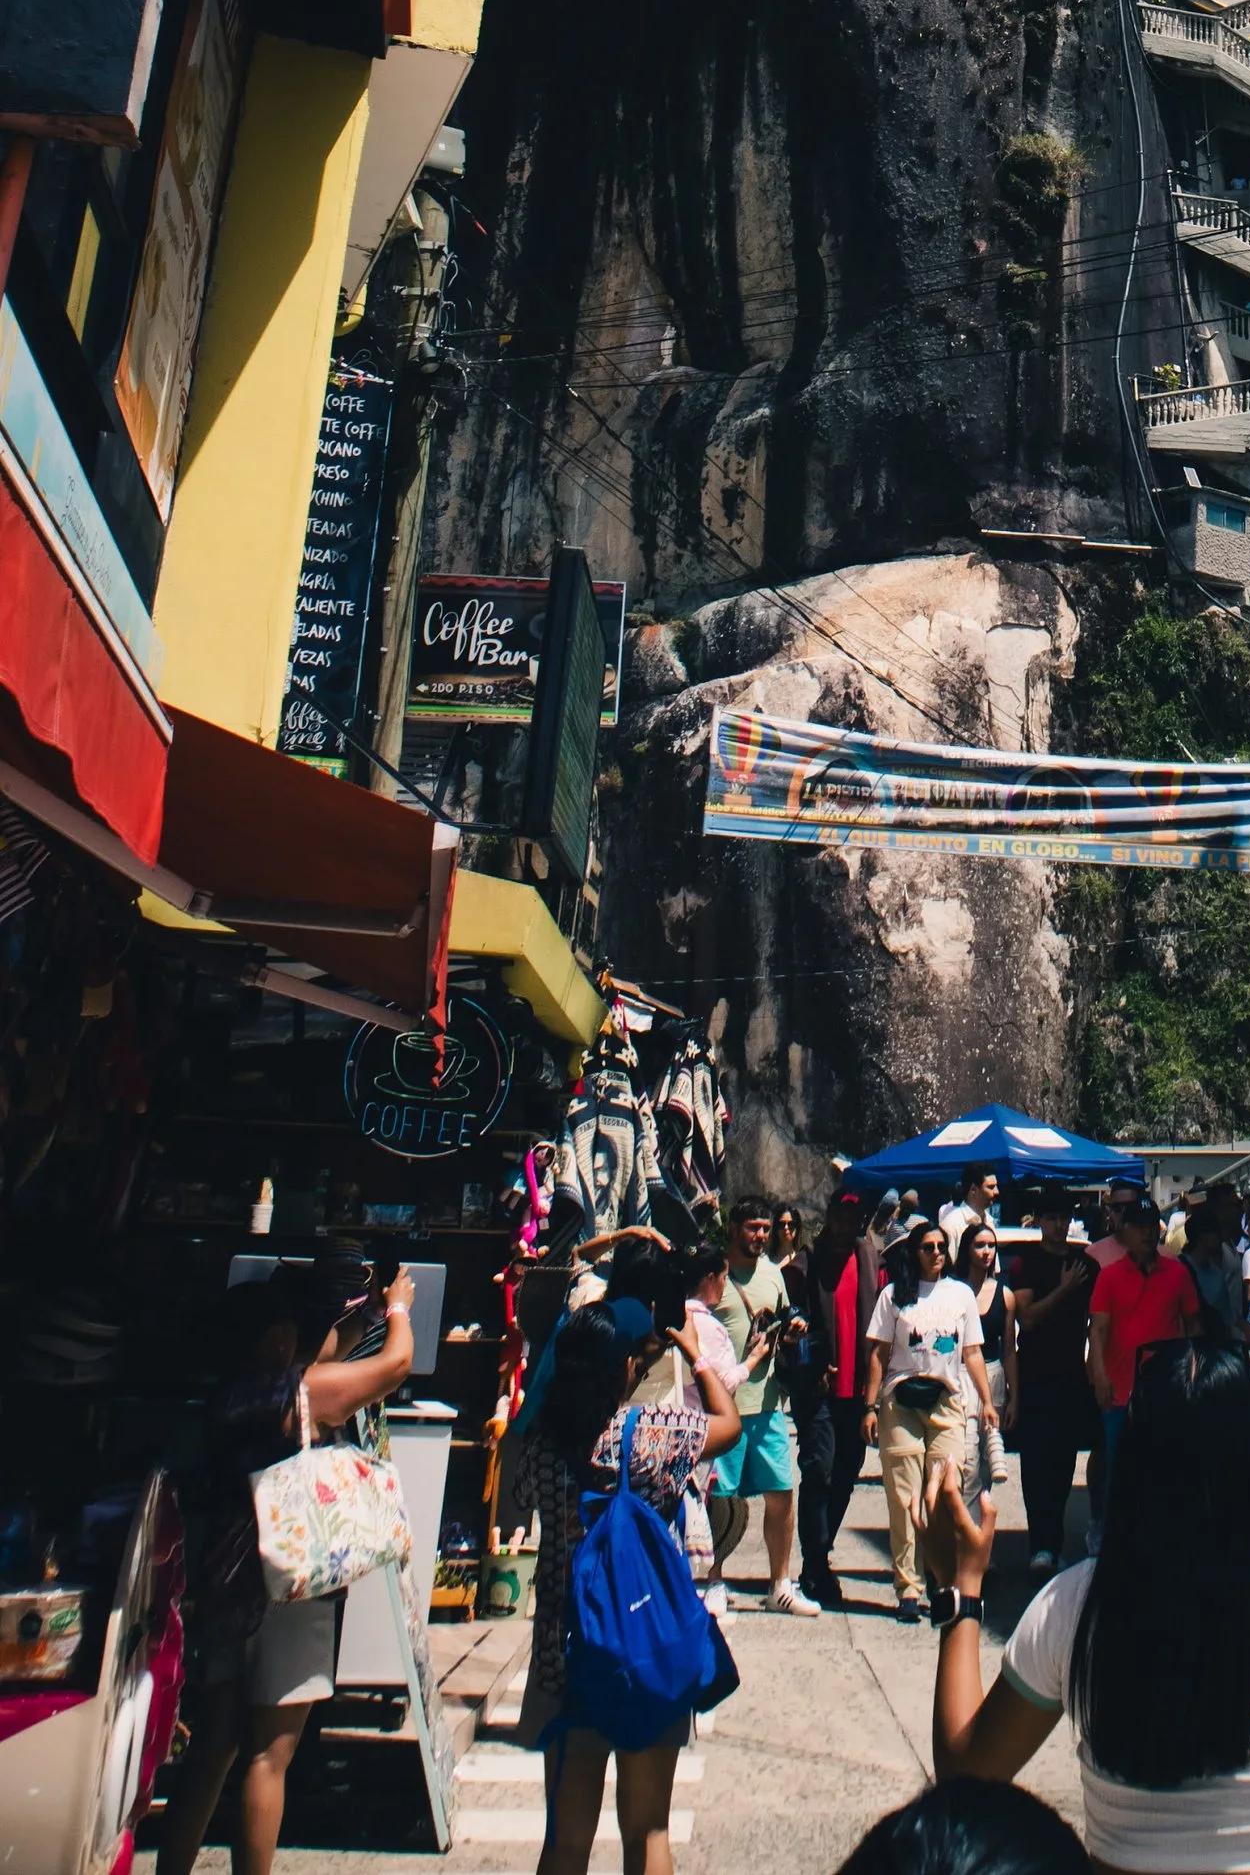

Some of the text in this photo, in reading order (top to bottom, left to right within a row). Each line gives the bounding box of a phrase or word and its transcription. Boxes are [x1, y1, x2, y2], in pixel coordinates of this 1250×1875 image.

[325, 393, 367, 414] COFFE
[345, 420, 385, 441] COFFE
[423, 598, 515, 662] Coffee
[476, 637, 531, 667] Bar
[431, 682, 494, 695] 2DO PISO
[818, 827, 841, 841] EL
[850, 828, 889, 845] QUE
[896, 831, 968, 852] MONTO
[979, 838, 1005, 854] EN
[1011, 840, 1097, 860] GLOBO...
[1111, 847, 1132, 862] SI
[1136, 848, 1184, 865] VINO
[1190, 849, 1202, 865] A
[1208, 852, 1229, 867] LA
[361, 1101, 478, 1148] COFFEE
